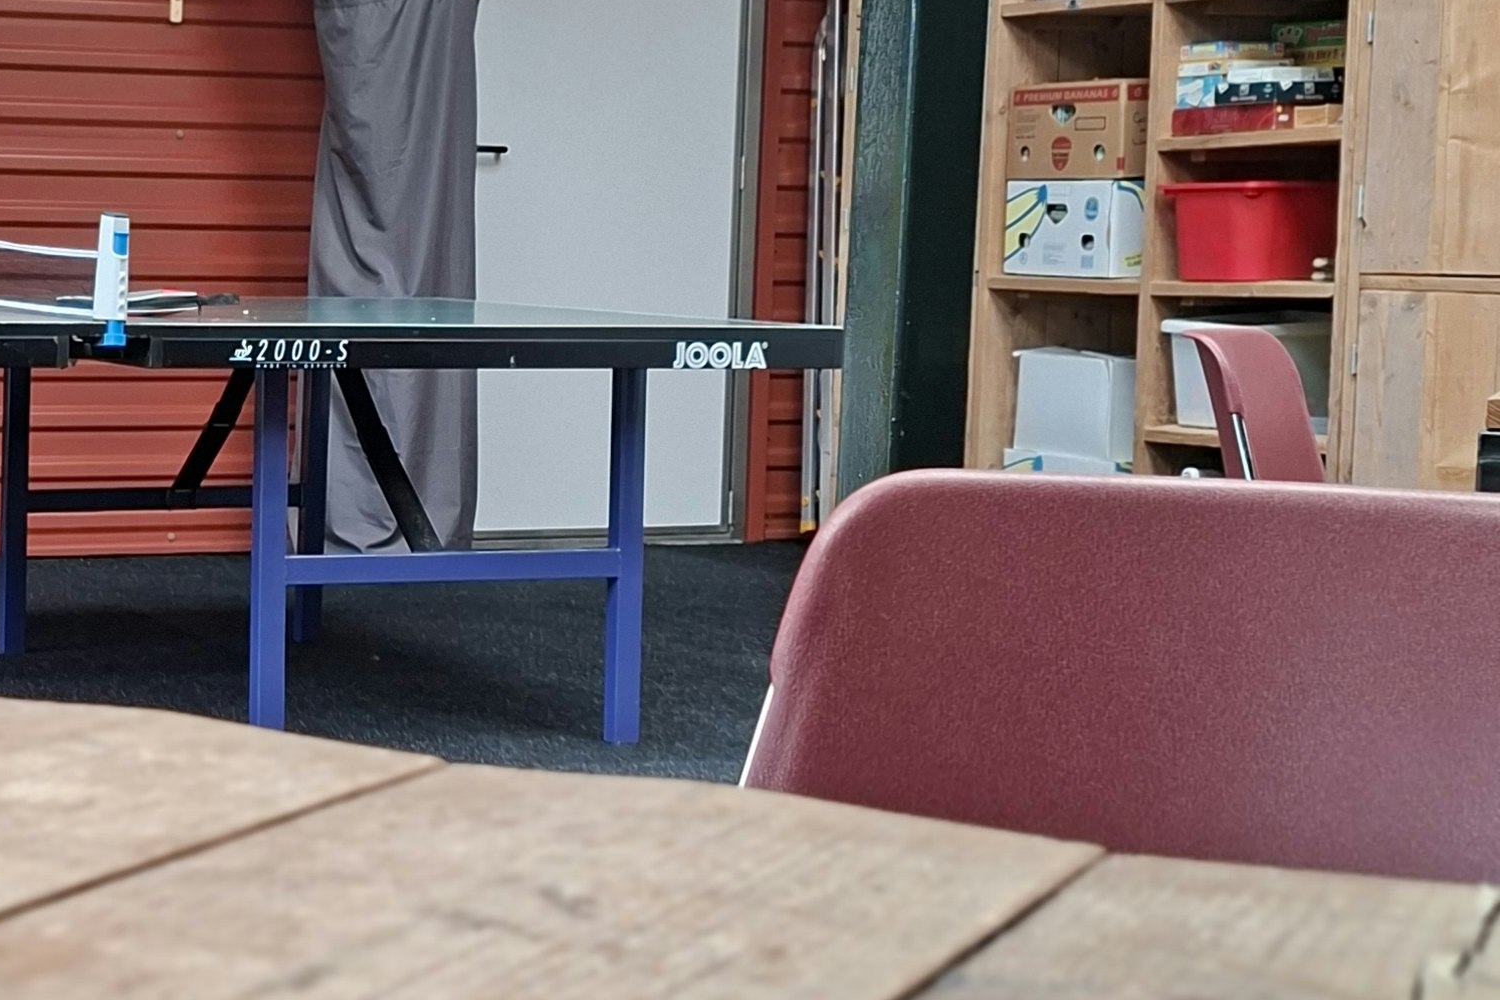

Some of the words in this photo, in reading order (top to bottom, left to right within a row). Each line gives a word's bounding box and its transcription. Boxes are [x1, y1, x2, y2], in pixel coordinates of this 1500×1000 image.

[1023, 90, 1062, 103] PREMIUM
[1063, 88, 1108, 100] BANANAS
[256, 338, 349, 361] 2000-S
[672, 341, 768, 370] JOOLA
